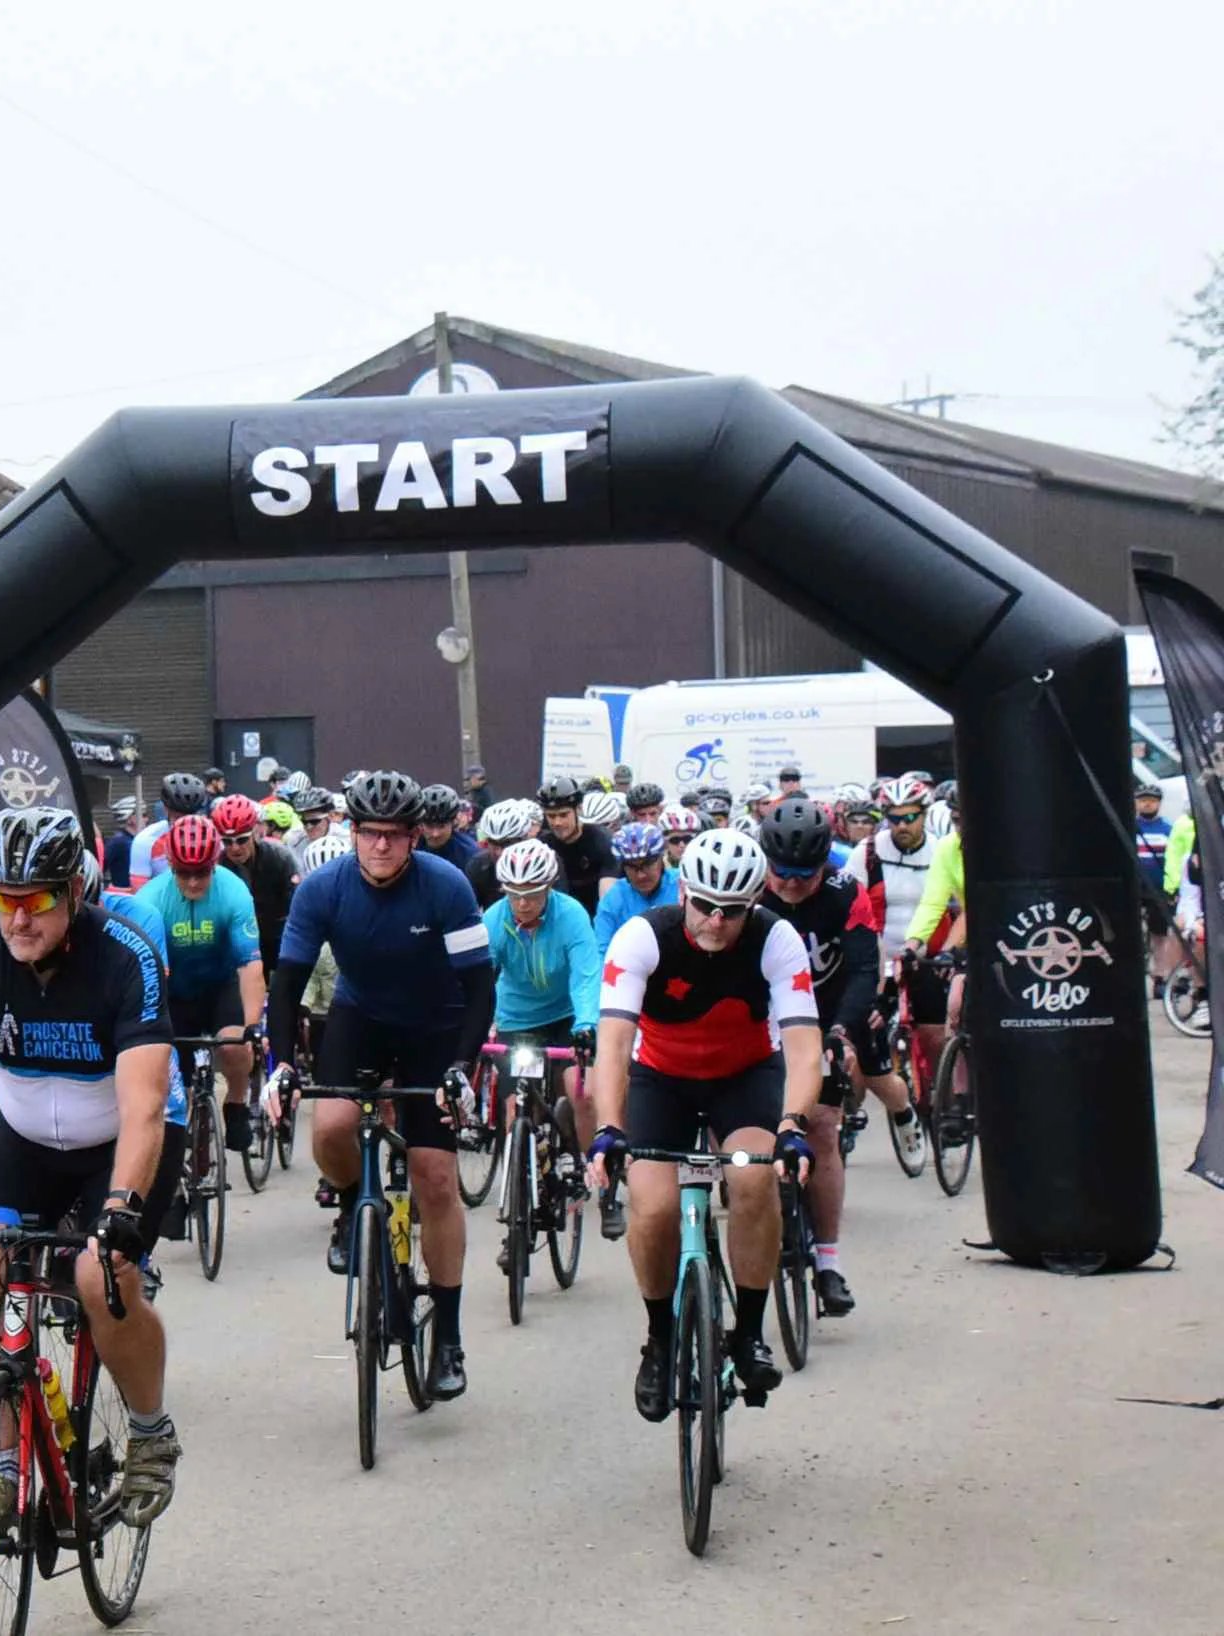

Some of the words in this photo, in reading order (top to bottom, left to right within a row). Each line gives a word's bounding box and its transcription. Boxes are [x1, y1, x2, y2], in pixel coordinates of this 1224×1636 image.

[251, 421, 587, 516] START
[685, 707, 821, 726] gc-cycles.co.uk
[1008, 902, 1056, 937] LET'S
[1067, 907, 1093, 932] GO
[103, 918, 154, 962] PROSTATE
[1022, 981, 1090, 1012] Velo
[22, 1022, 94, 1042] PROSTATE
[23, 1040, 81, 1060] CANCER
[82, 1042, 104, 1062] UK
